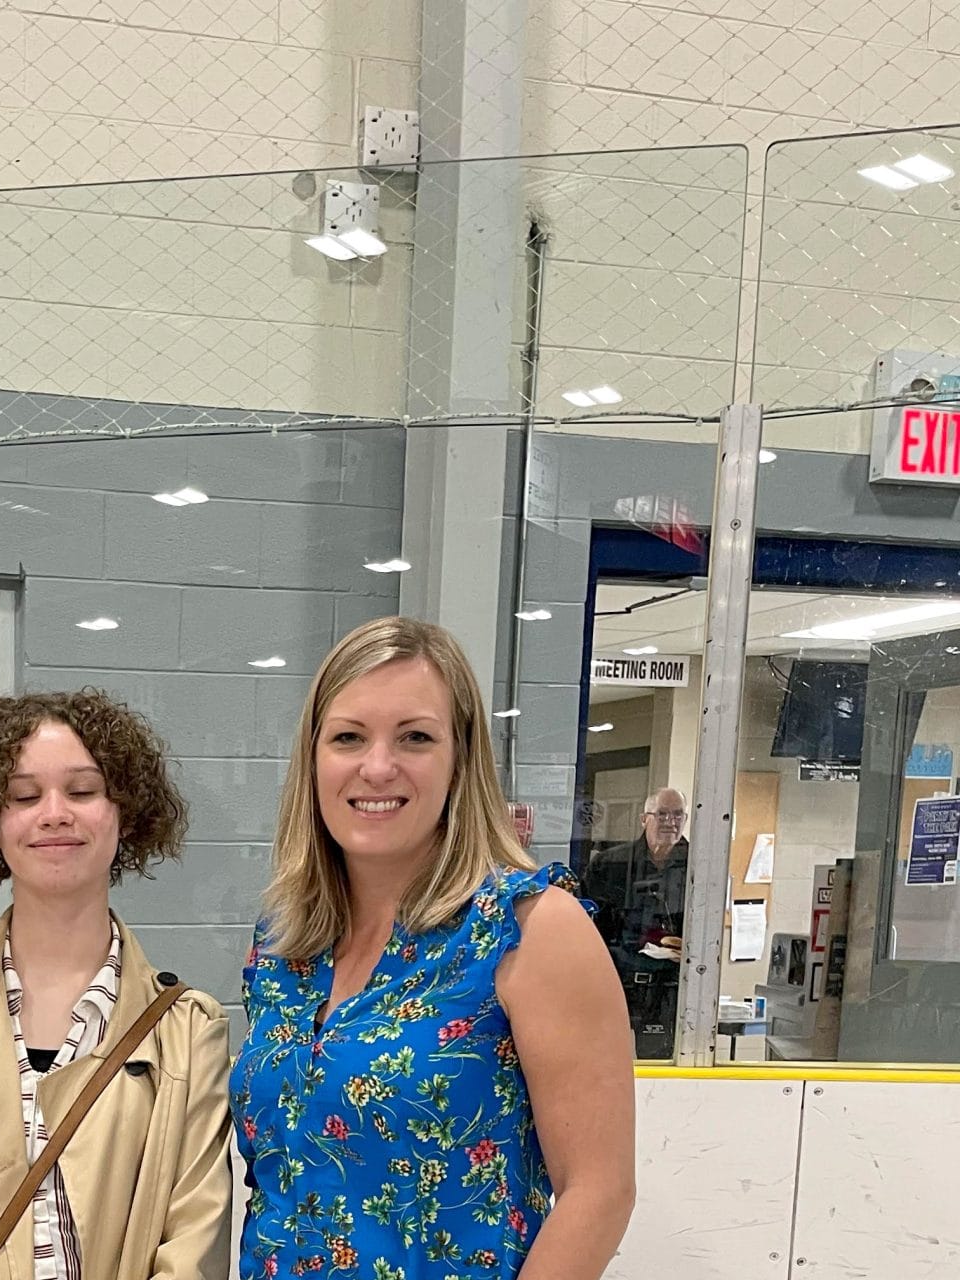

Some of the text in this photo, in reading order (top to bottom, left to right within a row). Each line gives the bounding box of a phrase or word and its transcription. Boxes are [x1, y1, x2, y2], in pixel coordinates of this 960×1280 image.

[901, 410, 960, 475] EXIT
[595, 659, 684, 681] MEETING ROOM
